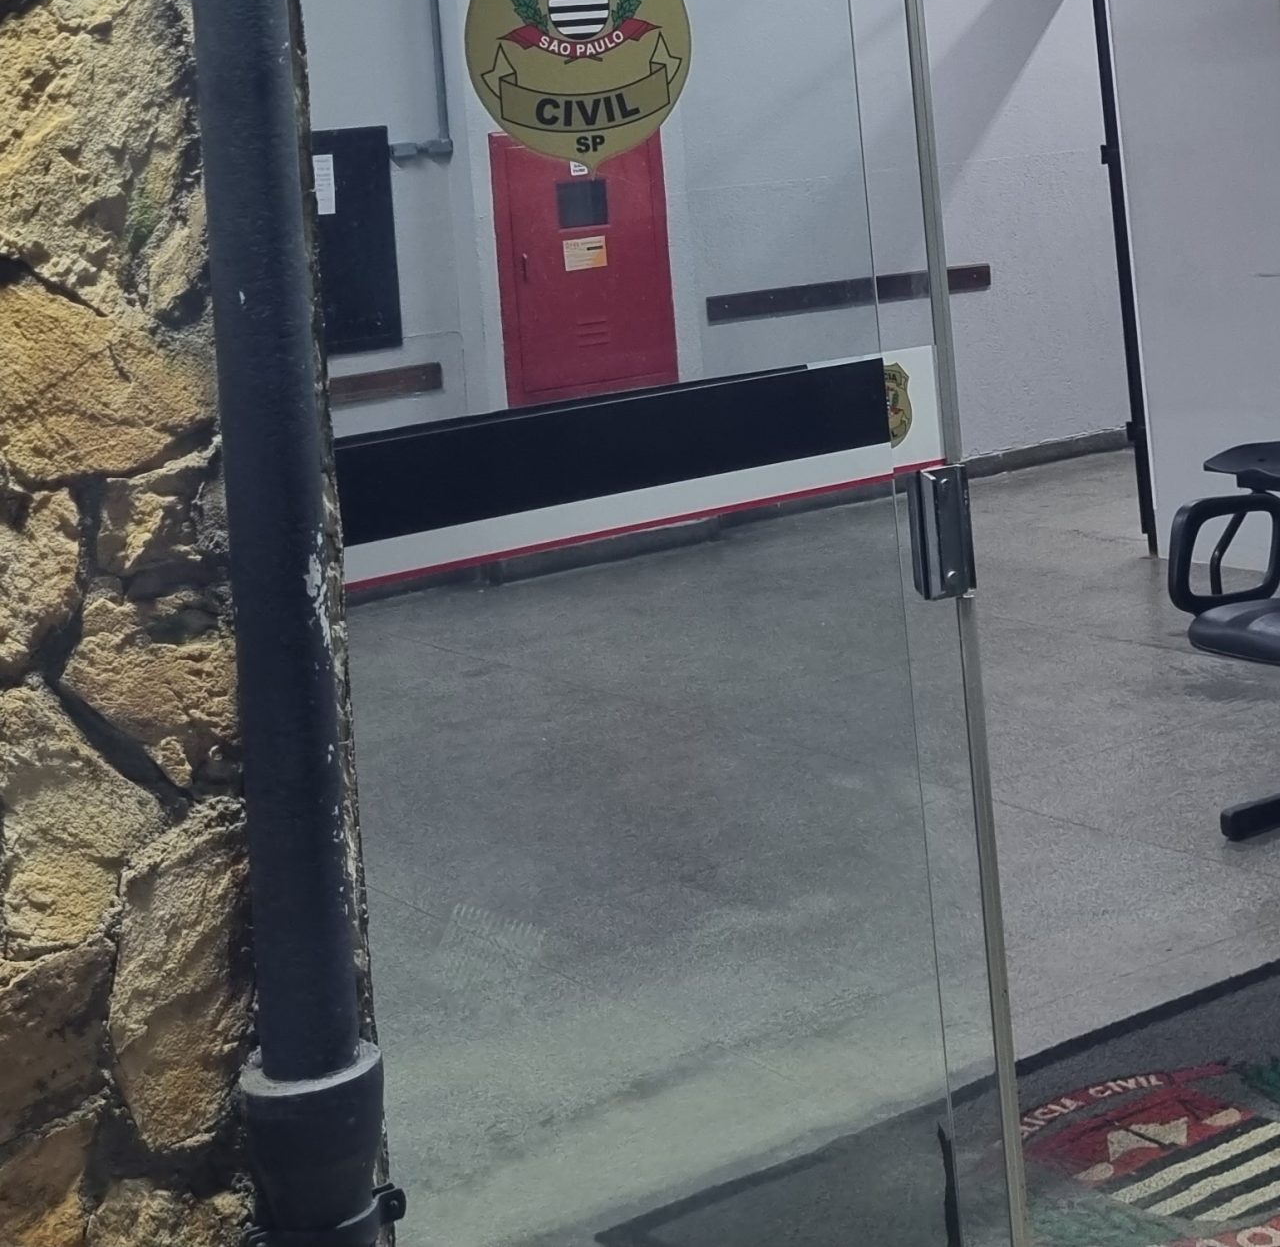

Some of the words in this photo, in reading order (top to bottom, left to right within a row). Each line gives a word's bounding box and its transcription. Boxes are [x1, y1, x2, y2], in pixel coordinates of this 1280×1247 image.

[576, 31, 624, 56] PAULO
[535, 92, 640, 127] CIVIL
[576, 135, 605, 154] SP
[1089, 1074, 1164, 1098] CIVIL
